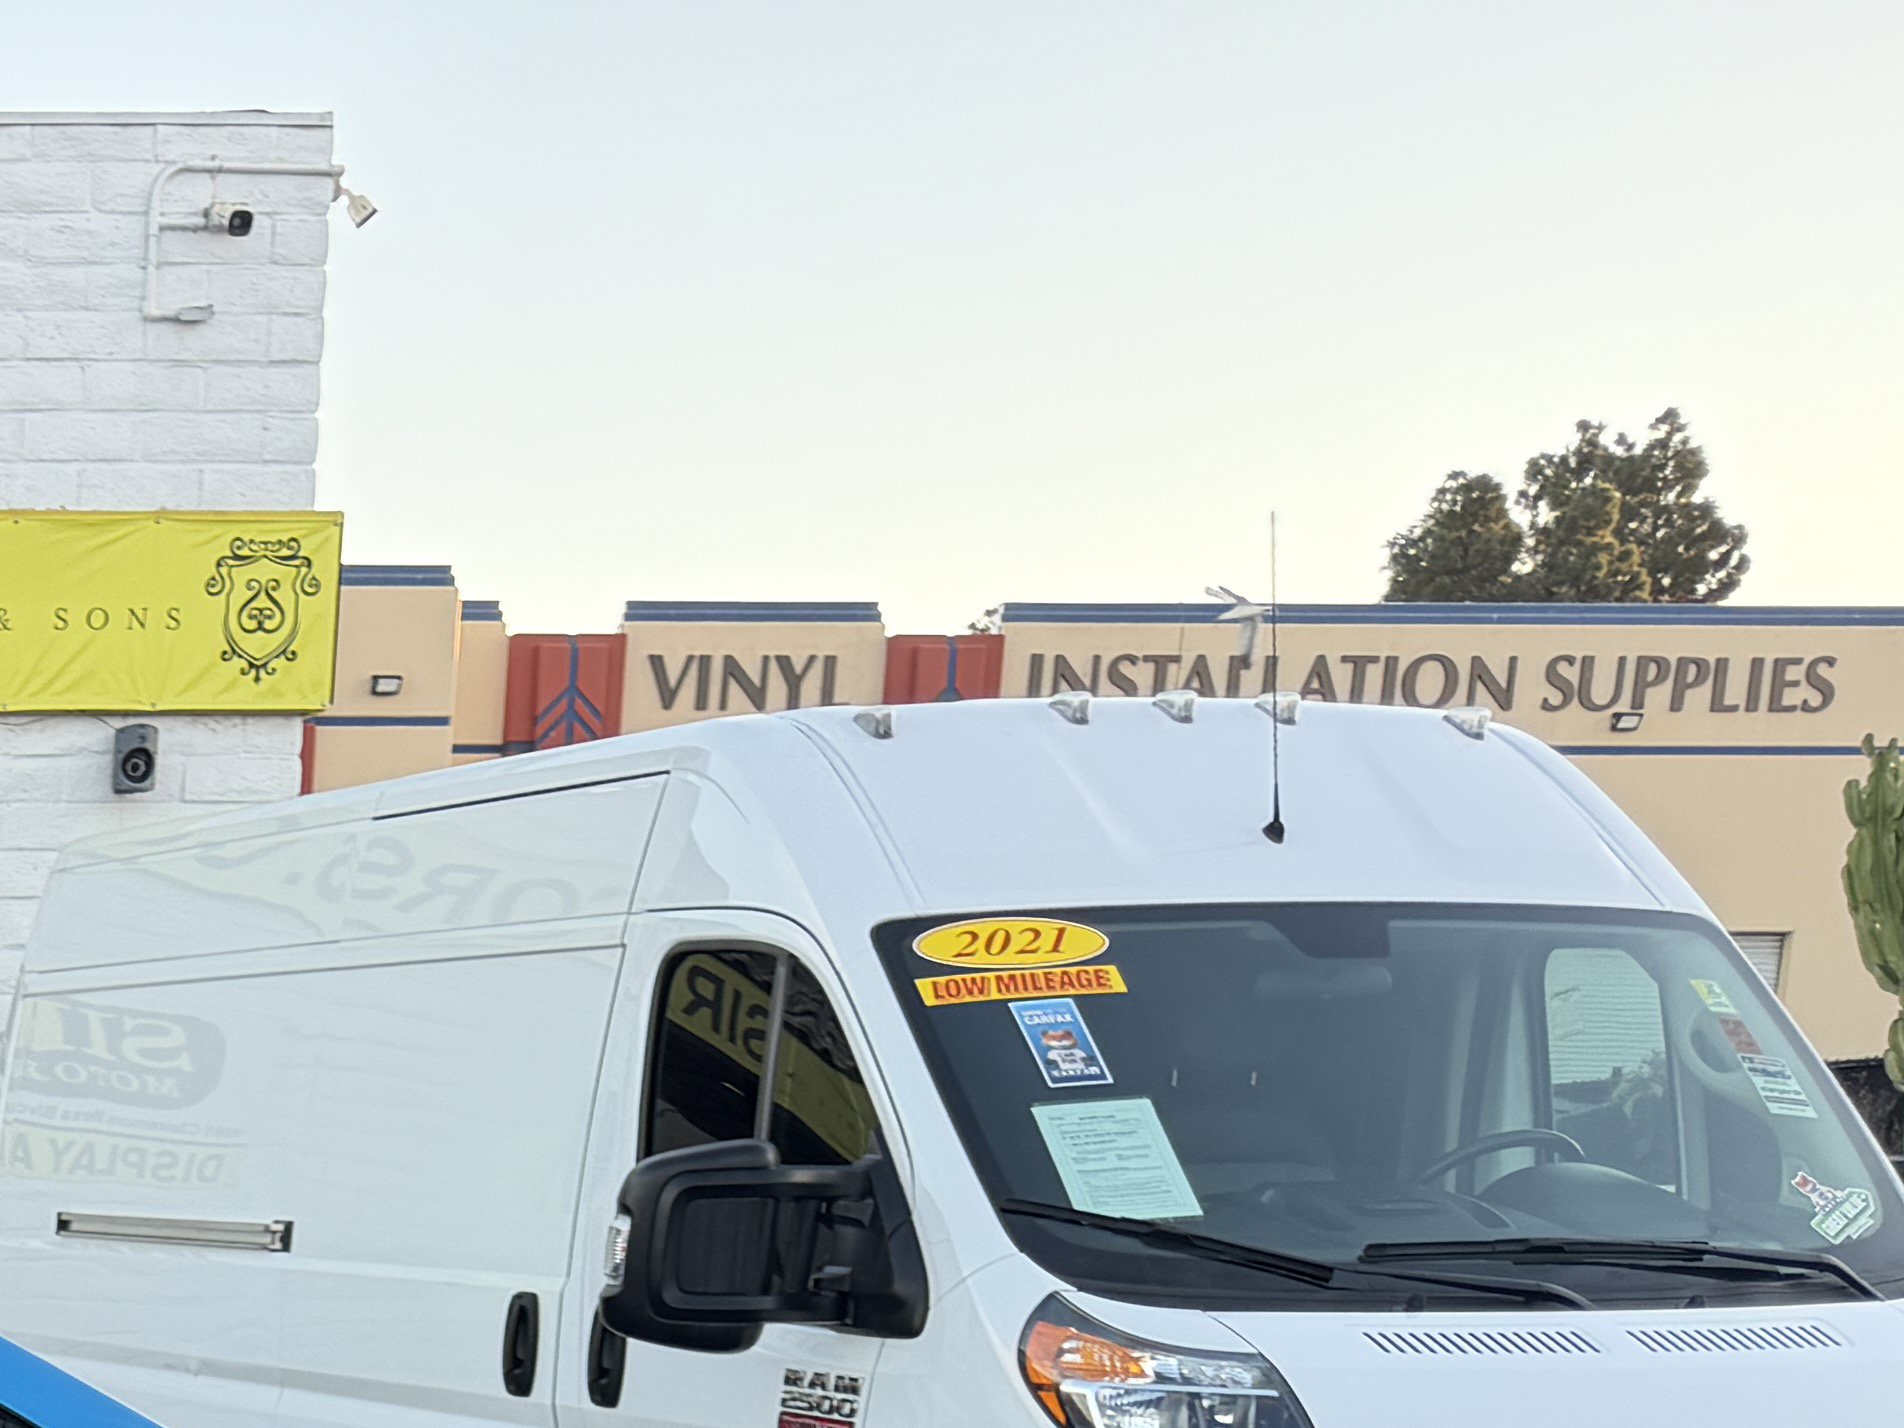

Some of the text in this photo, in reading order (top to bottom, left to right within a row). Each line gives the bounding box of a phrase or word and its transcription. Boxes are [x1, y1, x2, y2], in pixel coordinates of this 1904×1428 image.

[53, 606, 186, 632] SONS
[648, 652, 1839, 714] VINYL INSTALLATION SUPPLIES
[952, 927, 1067, 957] 2021
[931, 969, 1113, 1000] LOW MILEAGE
[784, 1368, 865, 1396] RAM
